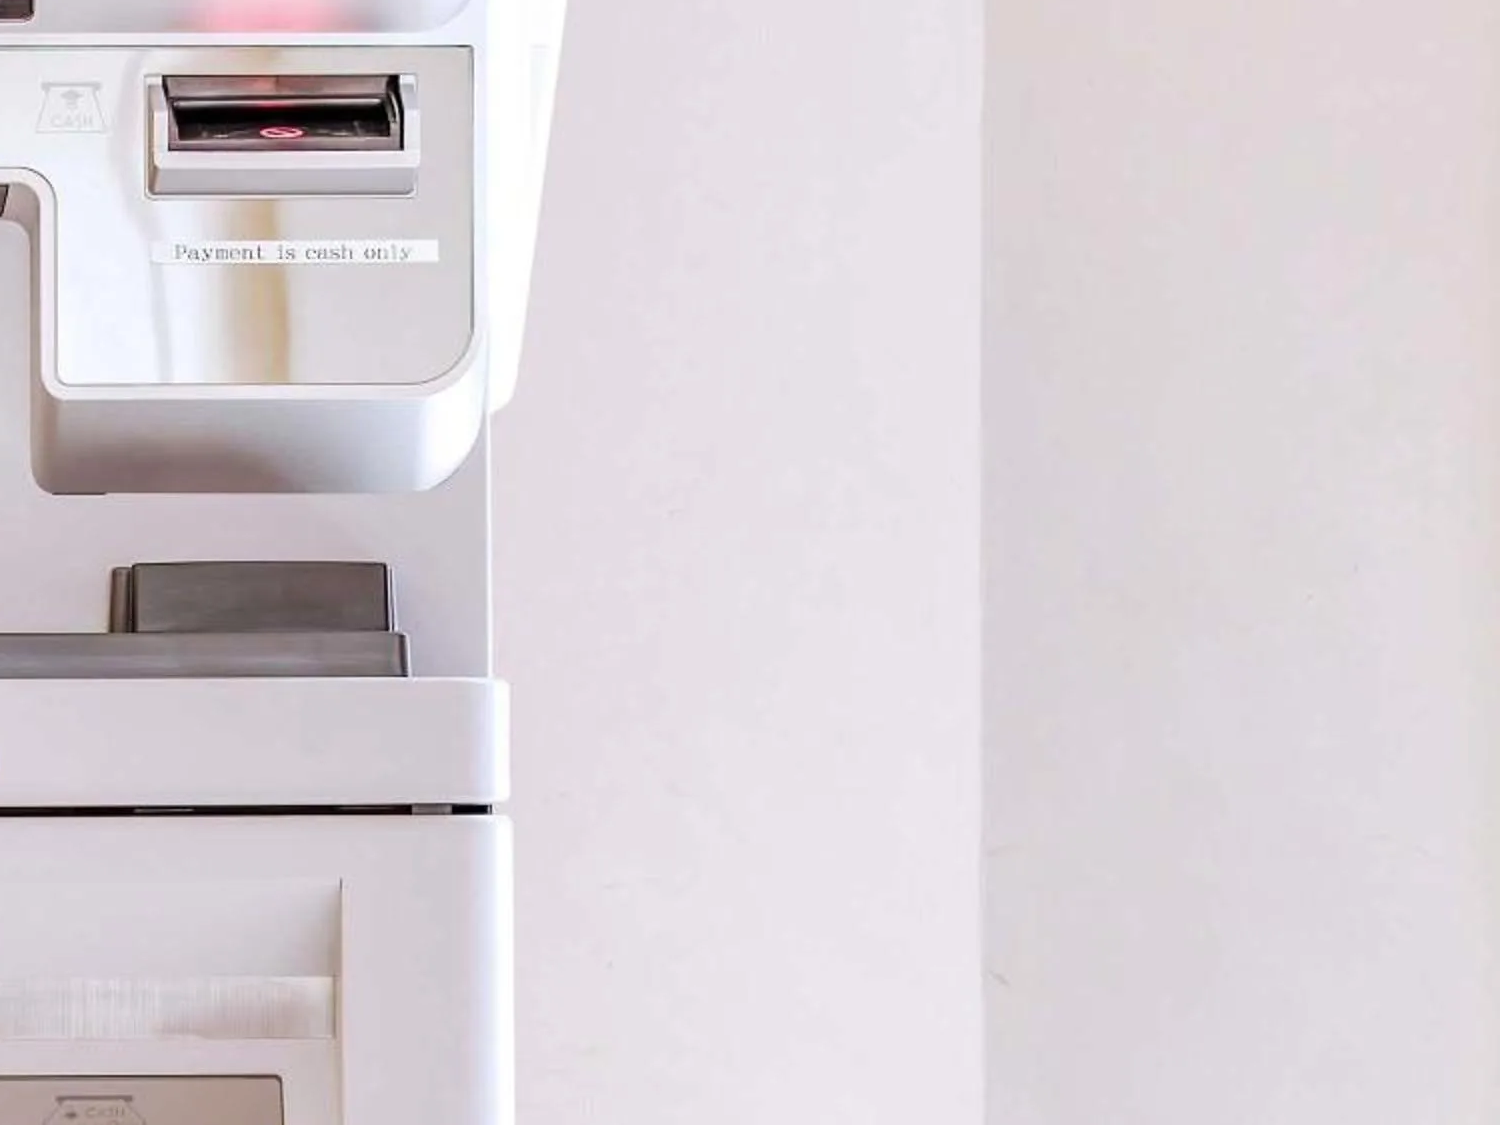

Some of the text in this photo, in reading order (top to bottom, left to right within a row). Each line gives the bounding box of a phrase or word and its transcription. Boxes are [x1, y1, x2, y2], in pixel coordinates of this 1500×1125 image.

[175, 243, 412, 262] Payment is cash only
